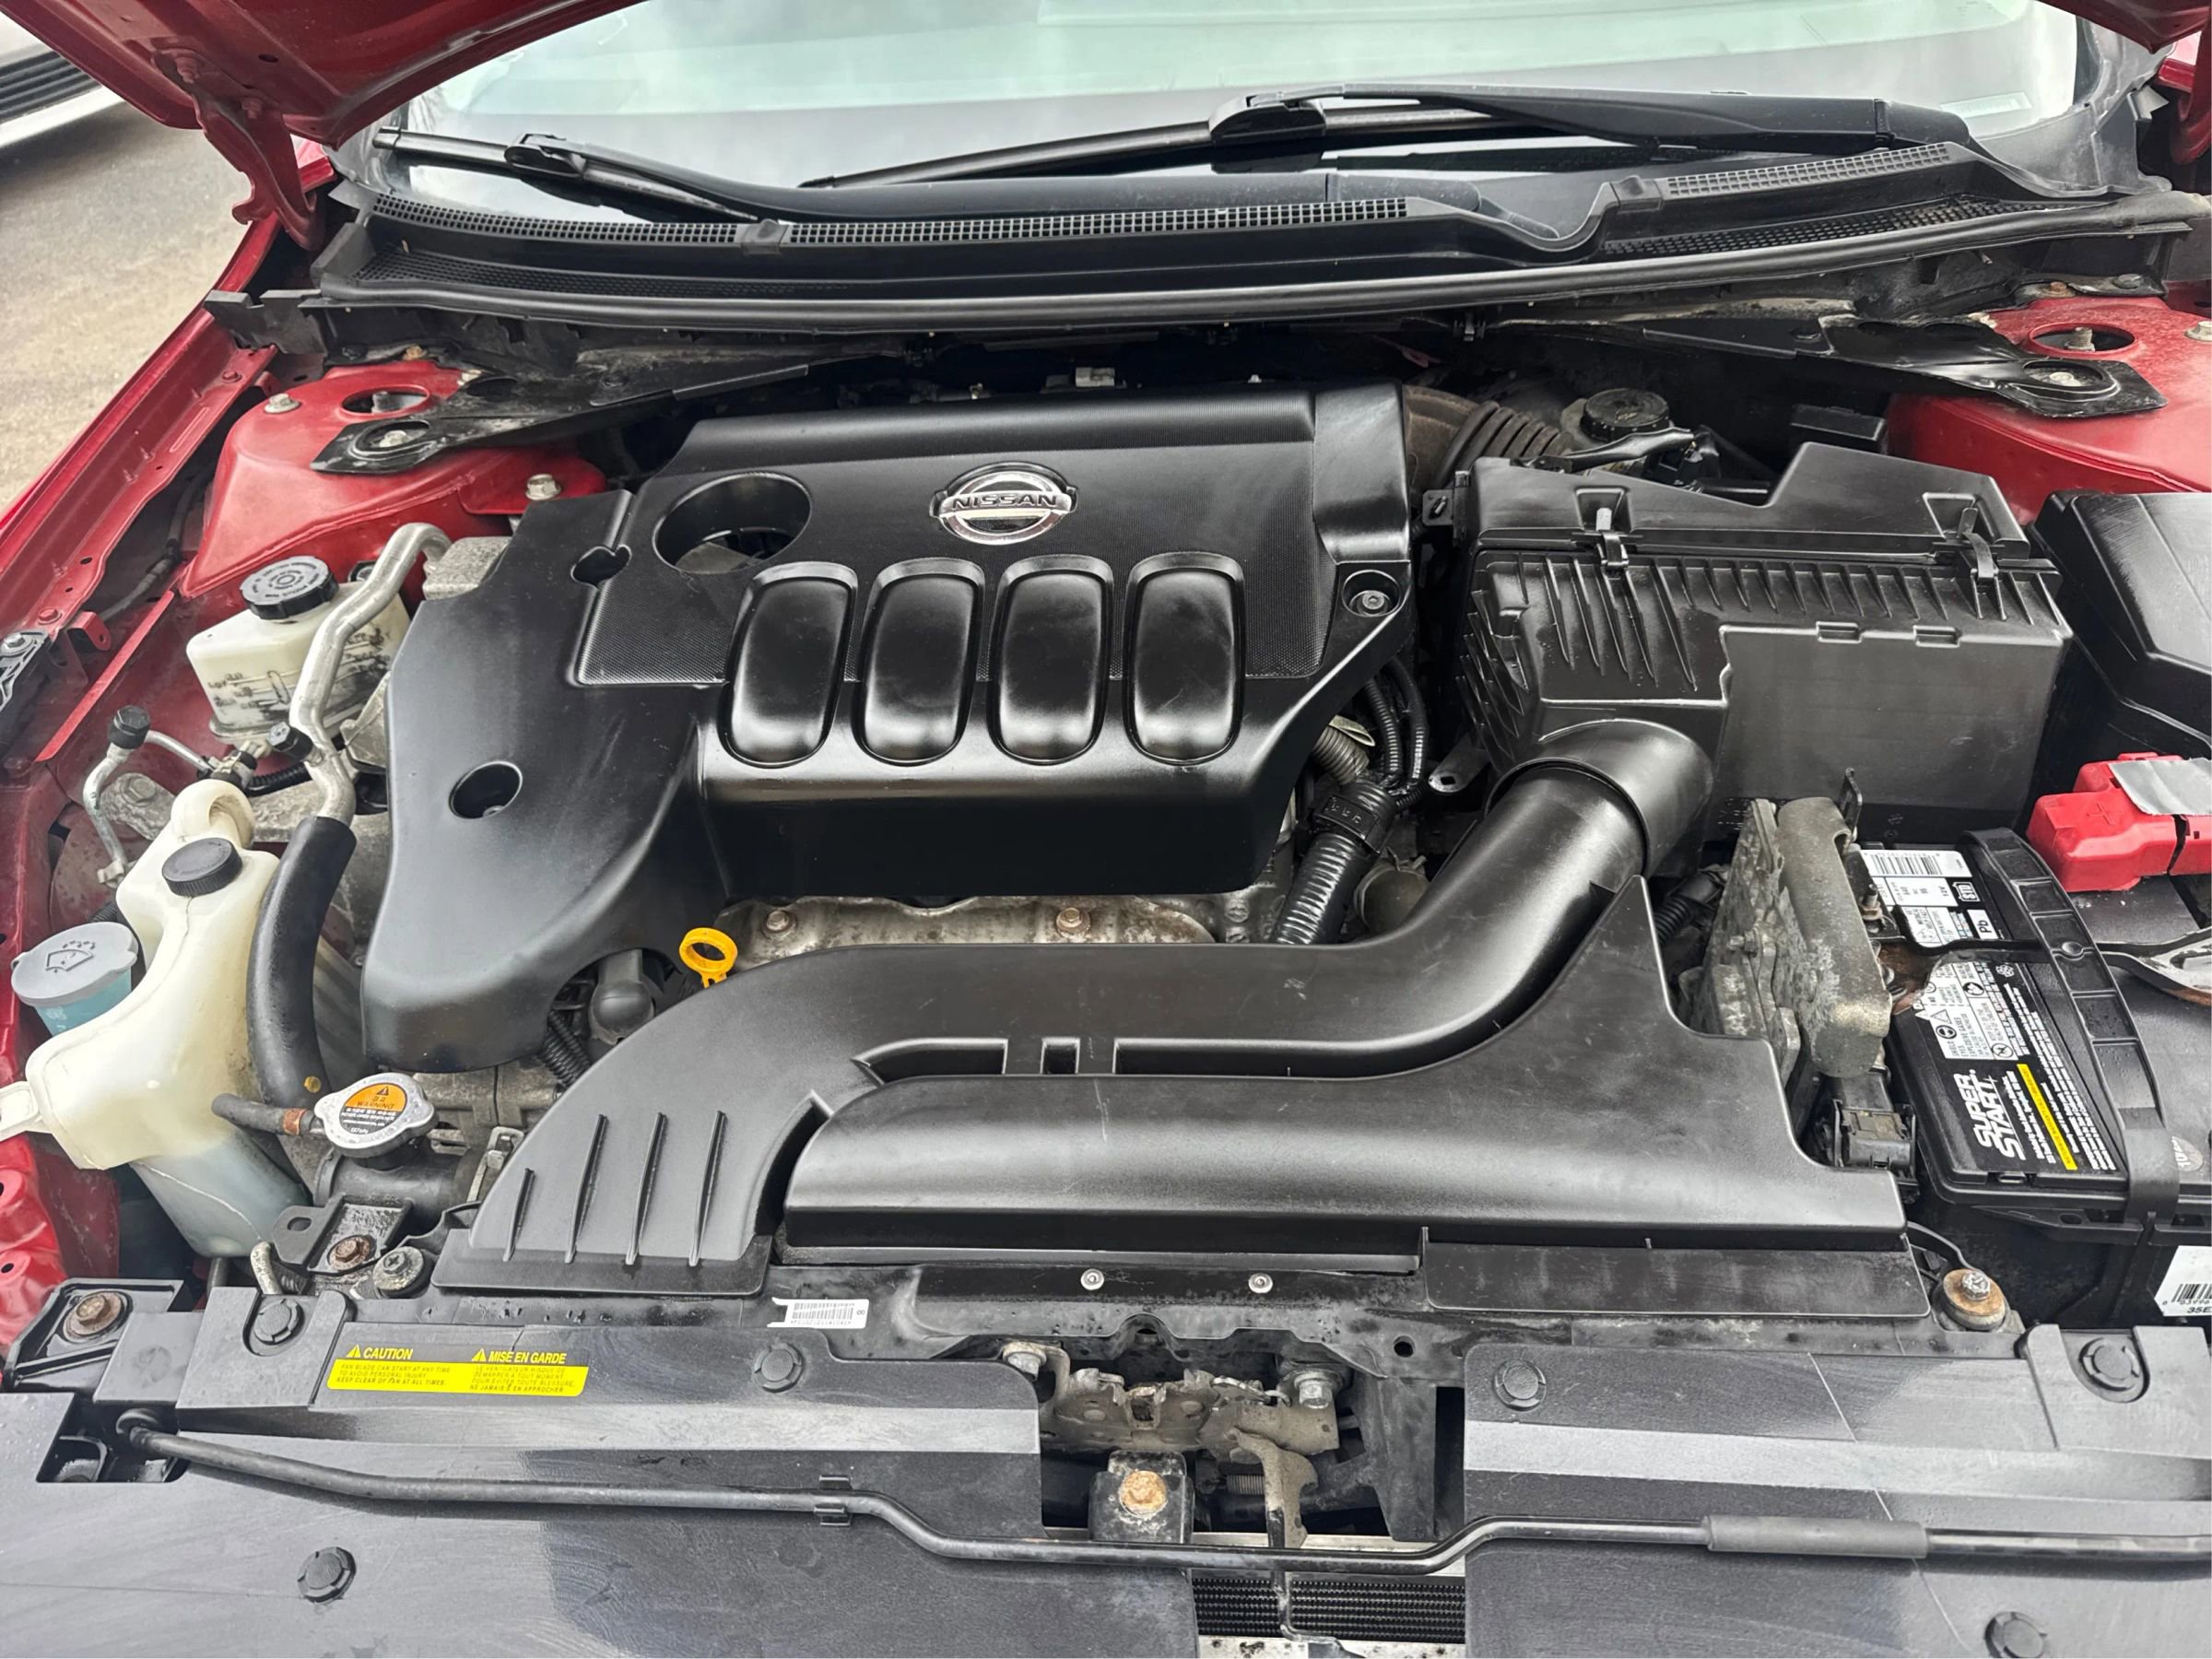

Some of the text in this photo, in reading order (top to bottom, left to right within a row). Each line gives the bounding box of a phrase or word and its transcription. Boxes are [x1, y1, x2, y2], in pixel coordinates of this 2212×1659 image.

[952, 494, 1057, 509] NISSAN
[1976, 920, 1993, 933] Pb
[357, 1100, 394, 1109] WARNING
[1953, 1073, 1993, 1147] SUPER
[1971, 1076, 2027, 1160] START
[363, 1347, 413, 1359] CAUTION
[488, 1351, 567, 1364] MISE EN GARDE
